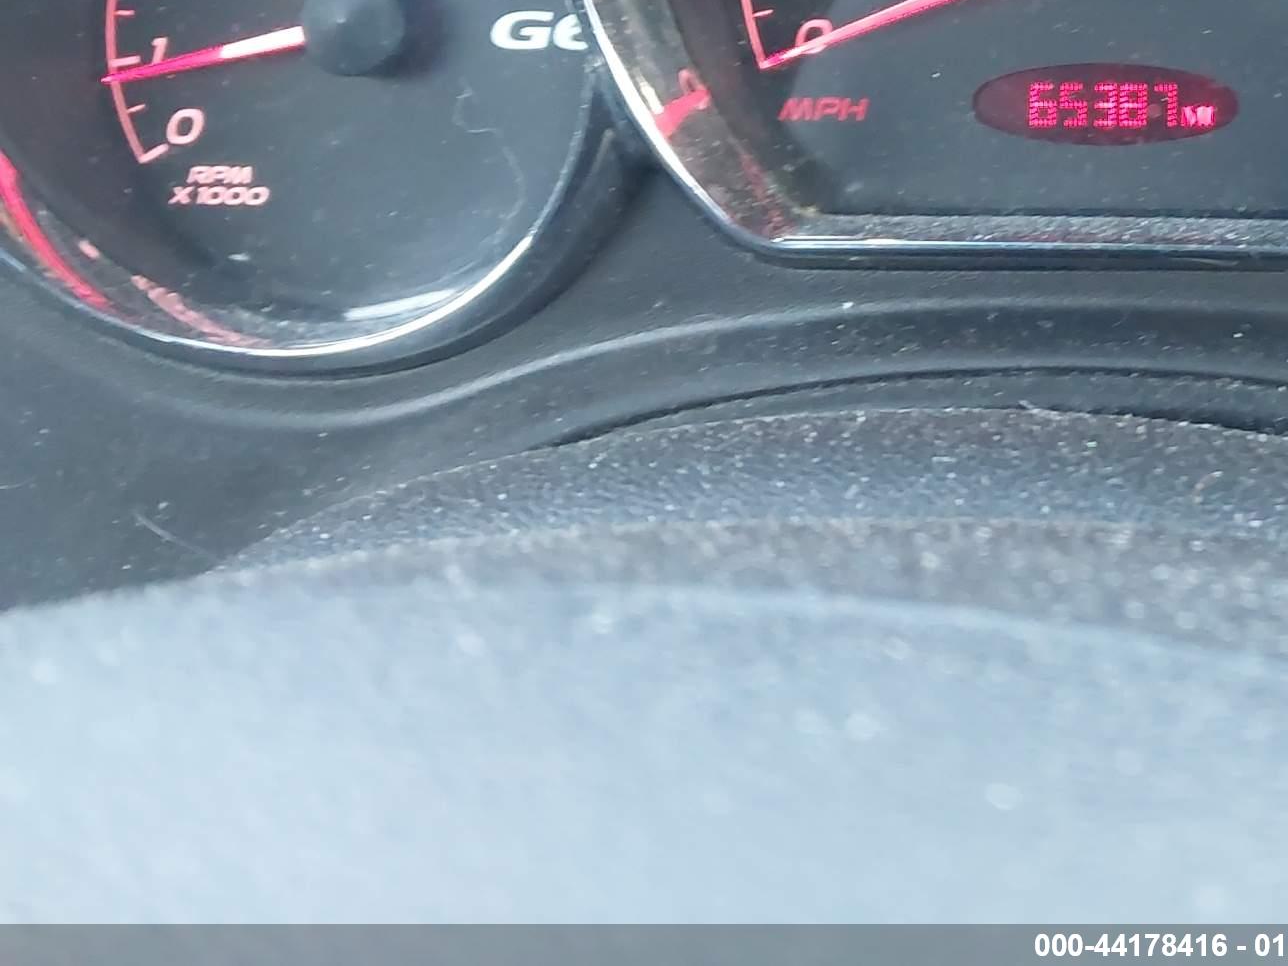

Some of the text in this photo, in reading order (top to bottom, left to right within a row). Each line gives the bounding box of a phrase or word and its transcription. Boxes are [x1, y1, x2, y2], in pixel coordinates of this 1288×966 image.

[151, 37, 168, 66] 1
[777, 97, 869, 121] MPH
[1028, 82, 1178, 128] 65387
[167, 108, 205, 145] 0
[186, 166, 253, 184] RPM
